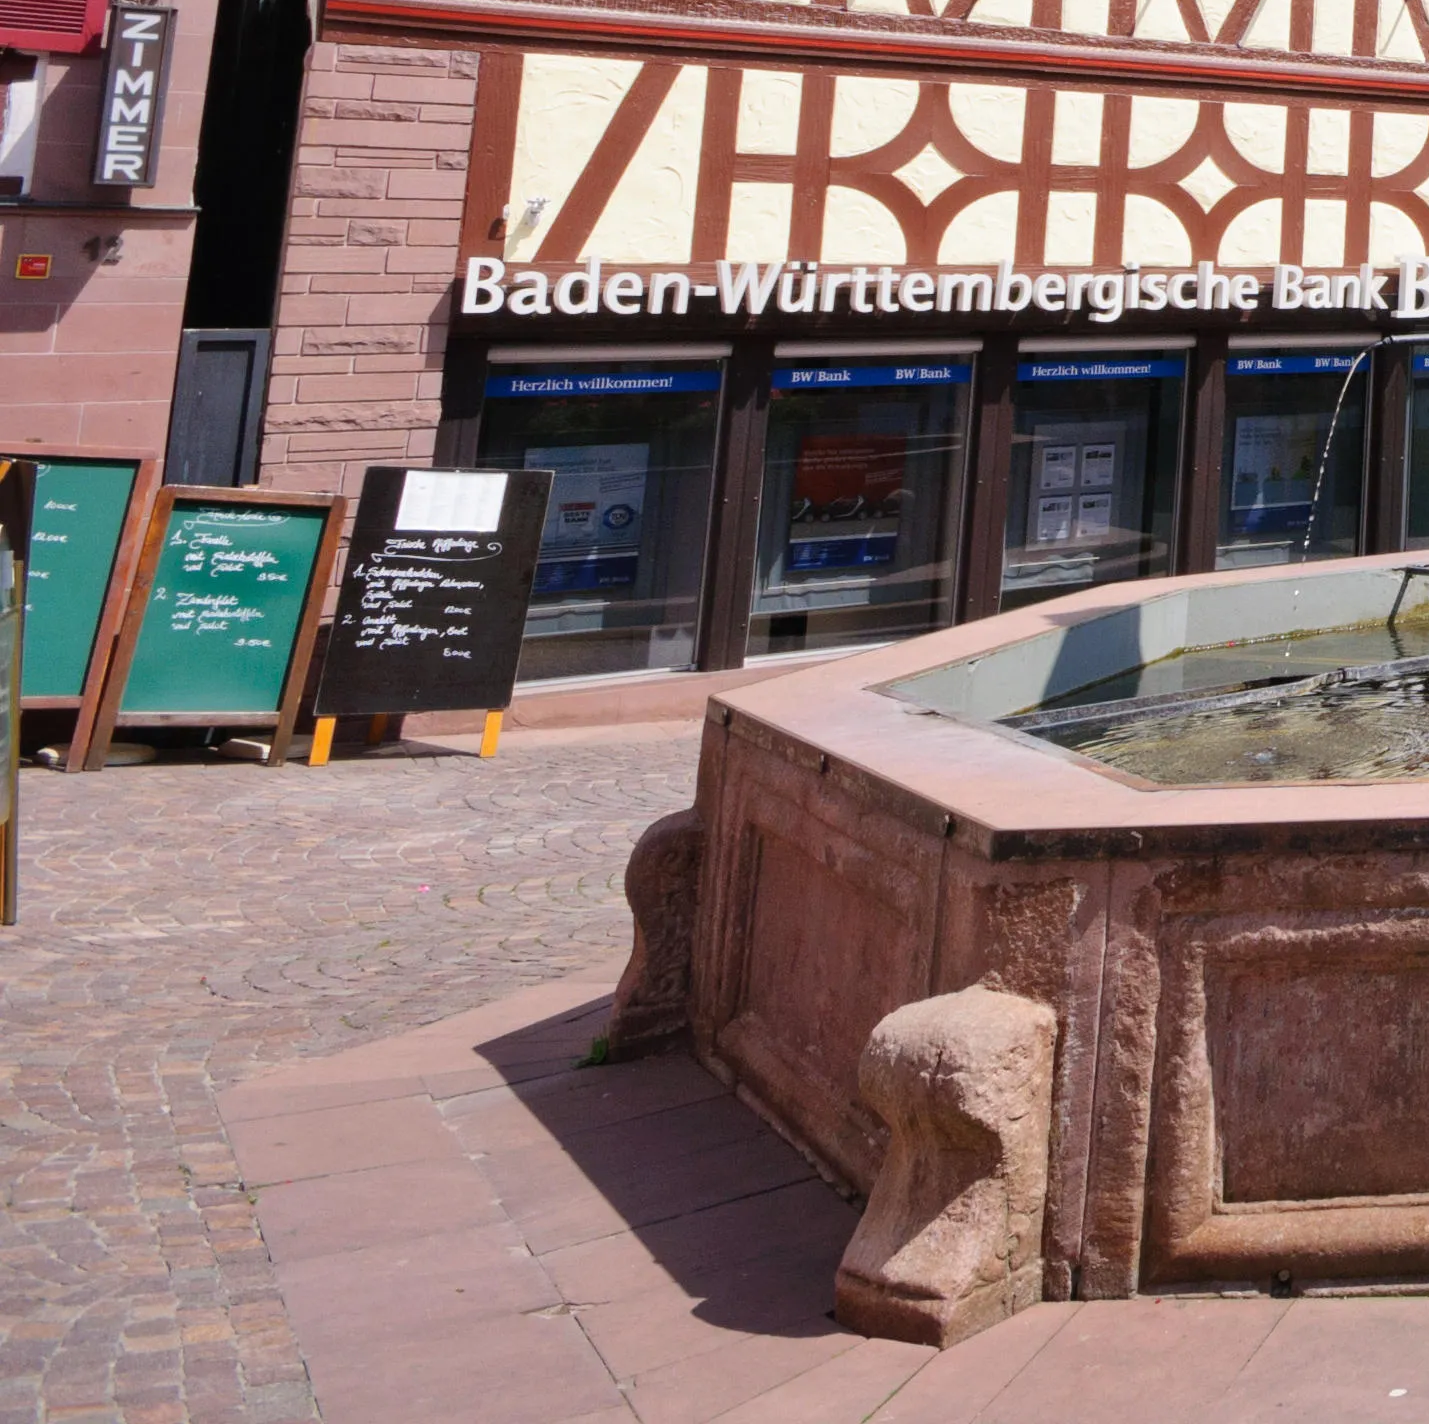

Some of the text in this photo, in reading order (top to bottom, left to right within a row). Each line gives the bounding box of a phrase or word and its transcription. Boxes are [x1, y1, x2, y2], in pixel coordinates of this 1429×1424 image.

[103, 14, 161, 180] ZIMMER
[461, 256, 1389, 323] Baden-Württembergische Bank
[511, 376, 673, 392] Herzlich willkommen!
[1032, 362, 1152, 377] Herzlich willkommen!
